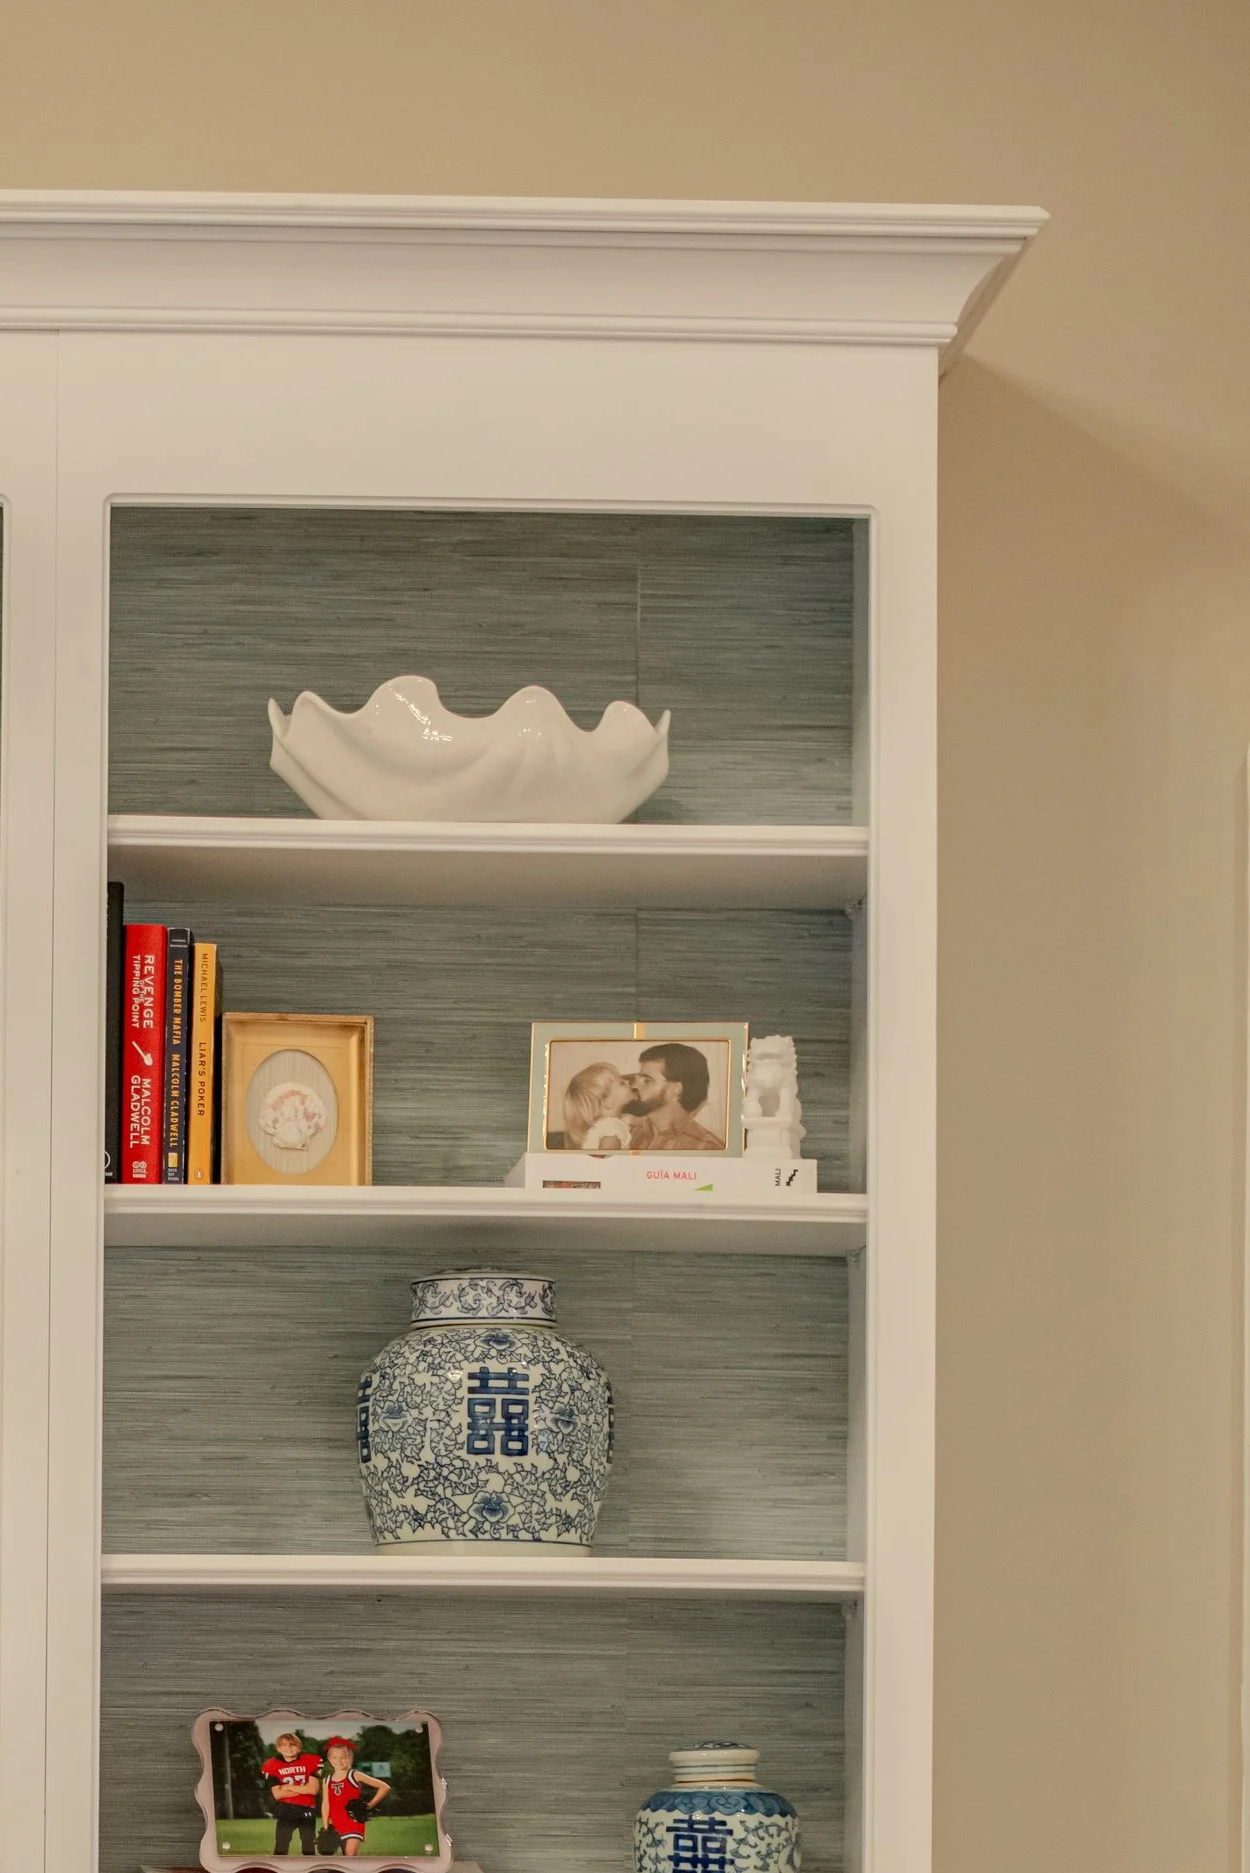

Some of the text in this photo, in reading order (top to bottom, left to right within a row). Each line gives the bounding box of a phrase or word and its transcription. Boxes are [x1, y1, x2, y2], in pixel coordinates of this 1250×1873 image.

[132, 955, 141, 1028] TIPPING POINT
[143, 955, 155, 1028] REVENGE
[172, 960, 183, 1045] THE BOMBER MAFIA
[199, 953, 209, 1022] MICHAEL LEWIS
[171, 1053, 181, 1097] MALCOLM
[197, 1042, 207, 1116] LIAR'S POKER
[130, 1075, 141, 1148] GLADWELL
[141, 1078, 151, 1145] MALCOLM
[646, 1168, 697, 1181] GUÍA MALI
[278, 1766, 306, 1776] NORTH
